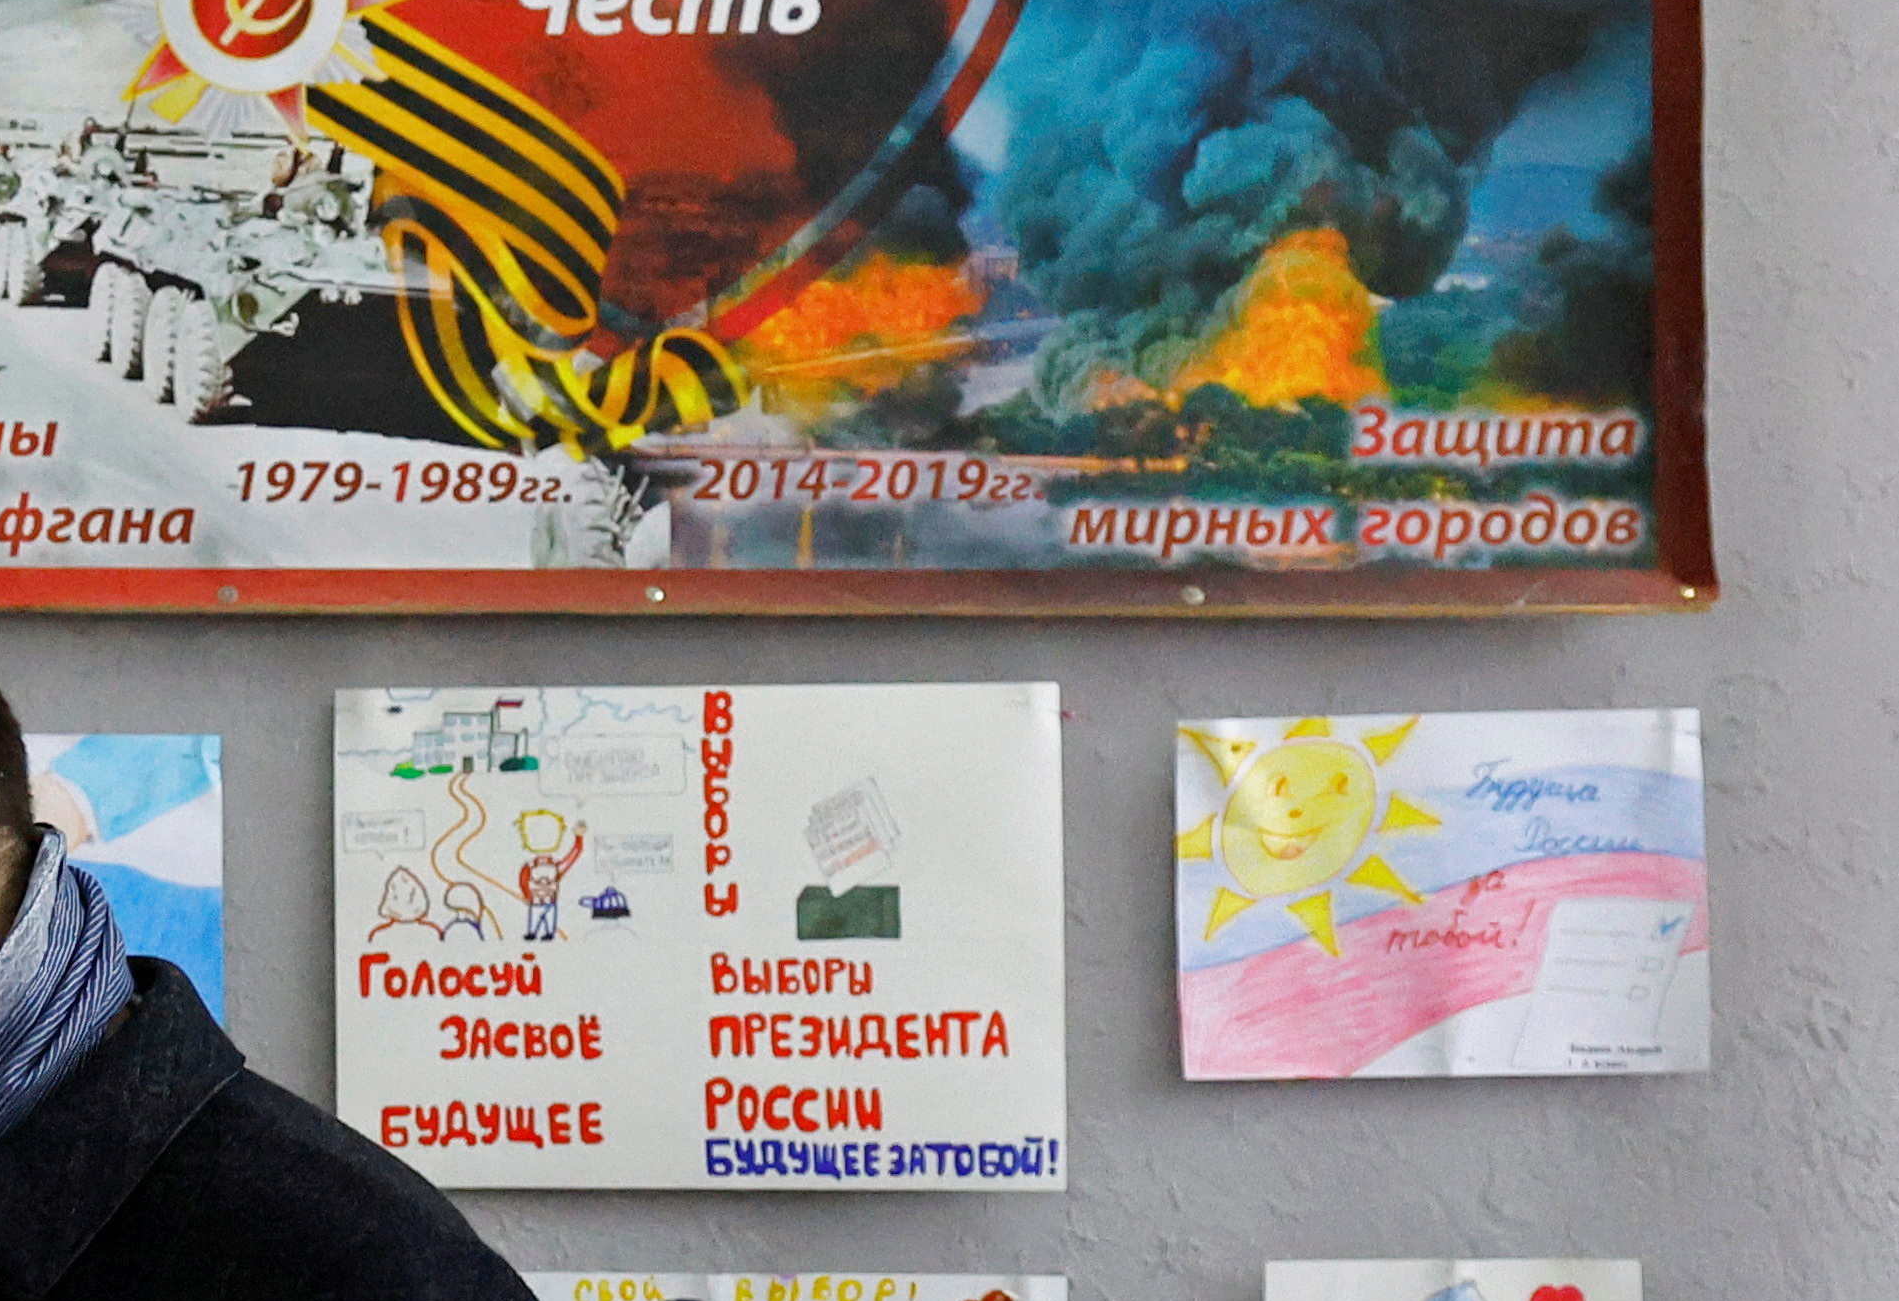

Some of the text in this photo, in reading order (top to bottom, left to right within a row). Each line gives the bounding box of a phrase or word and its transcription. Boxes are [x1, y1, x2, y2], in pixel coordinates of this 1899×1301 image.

[1351, 405, 1638, 467] Защита
[1068, 493, 1640, 559] мирных городов
[708, 1009, 1010, 1060] ПРЕЗИДЕНТА
[380, 1100, 604, 1149] БУДУЩЕЕ
